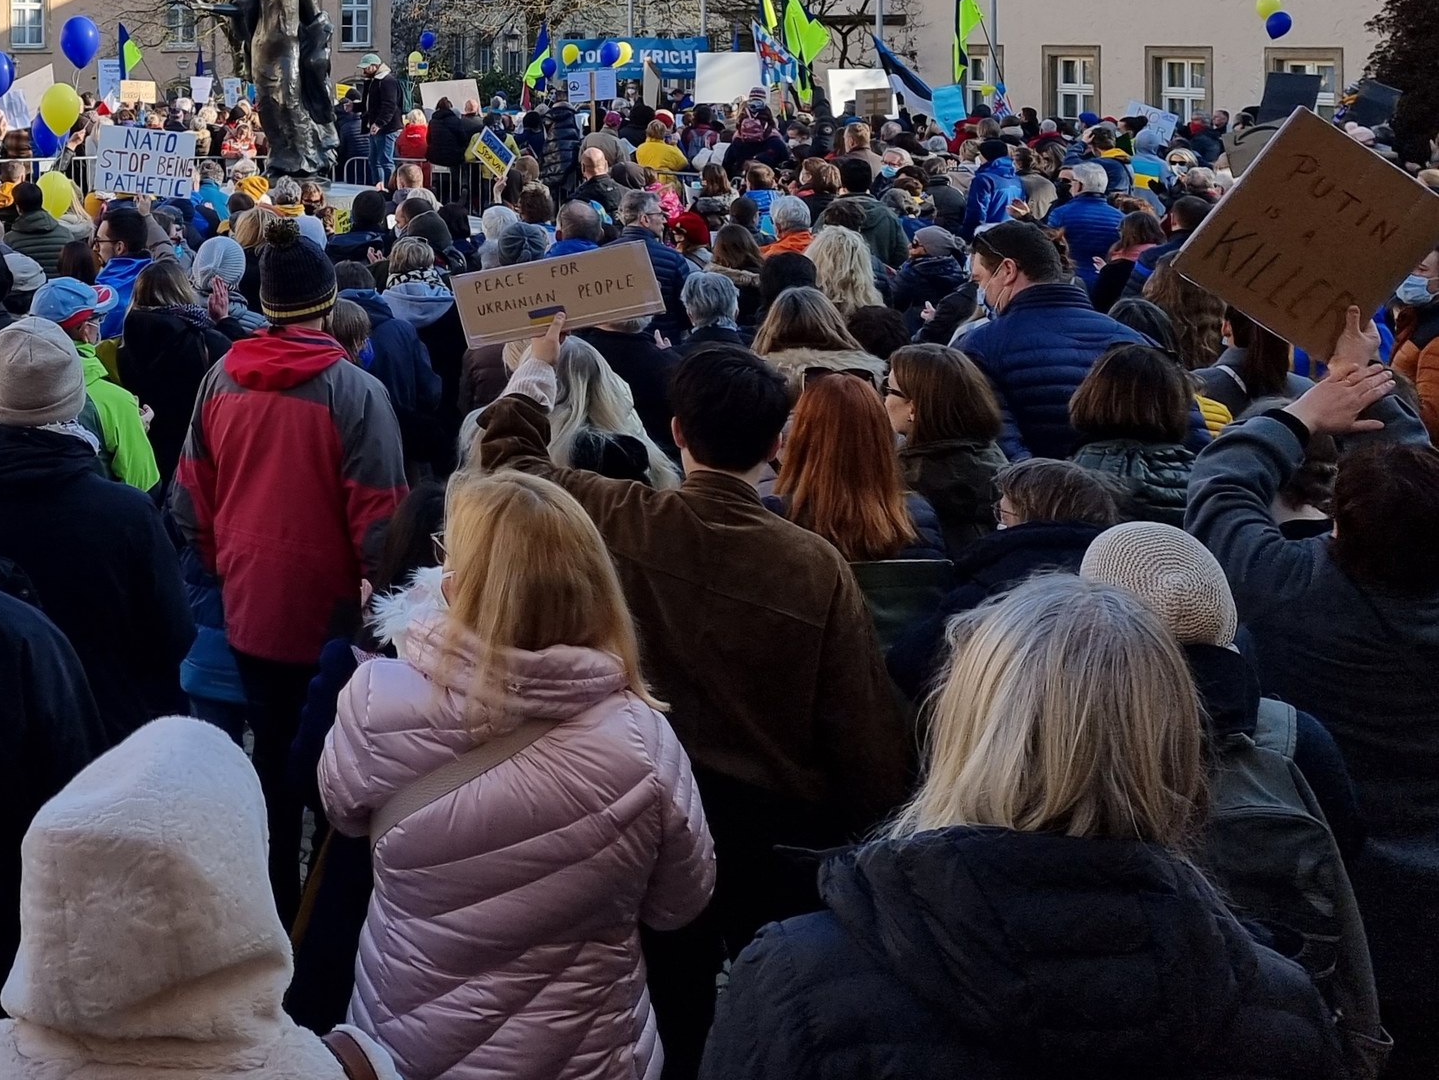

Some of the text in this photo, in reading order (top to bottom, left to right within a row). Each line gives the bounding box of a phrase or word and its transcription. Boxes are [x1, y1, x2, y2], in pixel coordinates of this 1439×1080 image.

[100, 149, 151, 173] STOP
[104, 172, 187, 197] PATHETIC
[1287, 153, 1400, 245] PUTIN
[1264, 204, 1282, 220] IS
[474, 261, 580, 295] PEACE FOR
[1201, 220, 1358, 332] KILLER
[477, 274, 635, 317] UKRAINIAN PEOPLE
